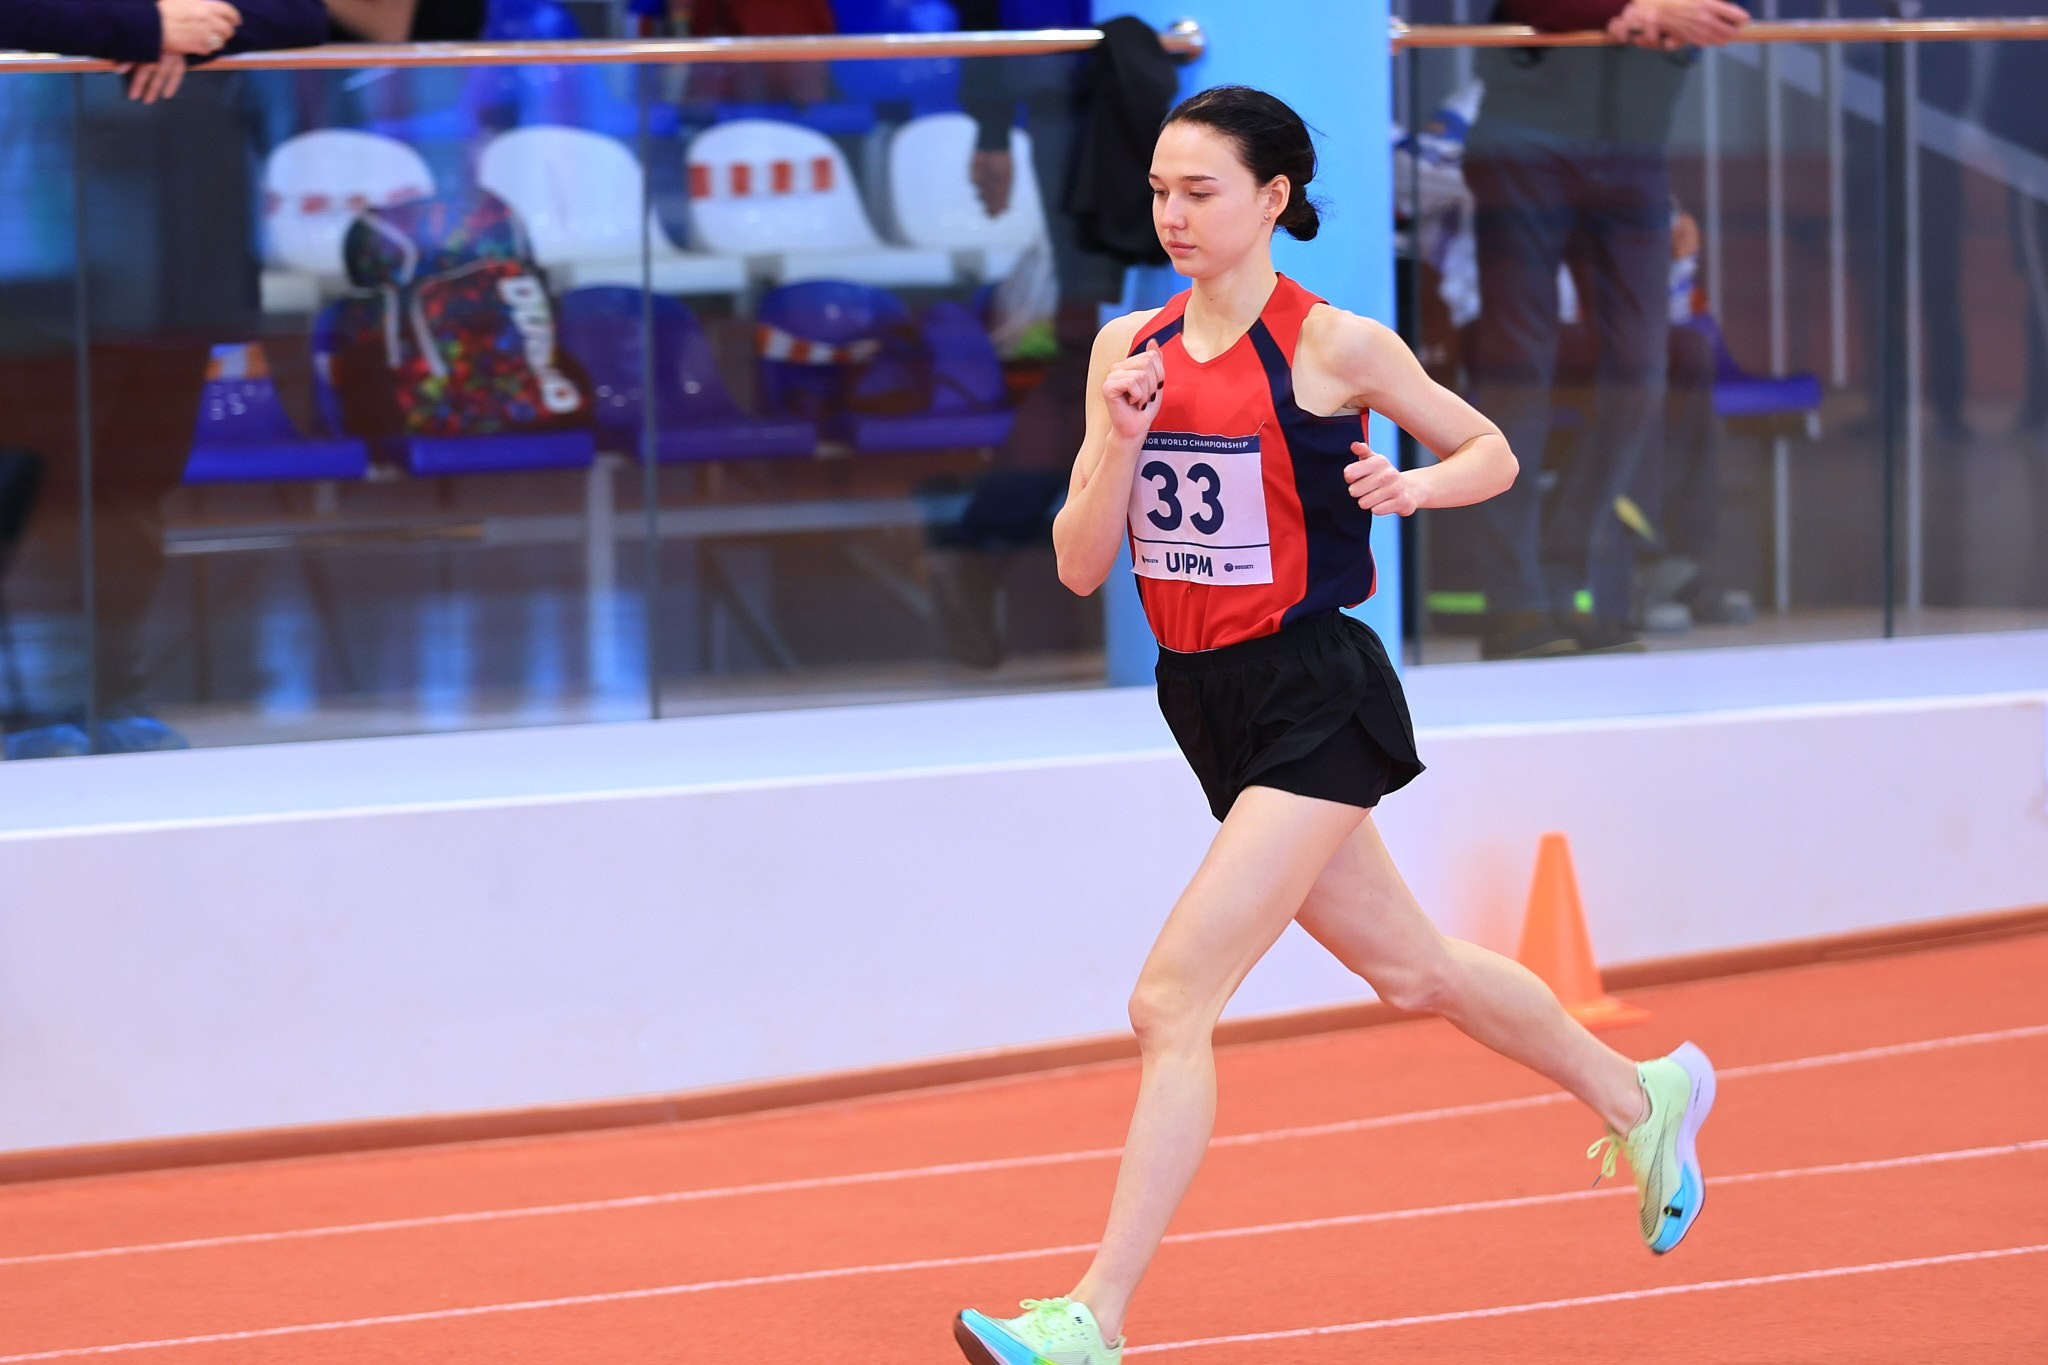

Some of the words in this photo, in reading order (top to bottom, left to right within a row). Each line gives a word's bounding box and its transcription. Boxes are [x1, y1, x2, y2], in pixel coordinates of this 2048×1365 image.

[1145, 437, 1159, 445] IOR
[1160, 438, 1188, 446] WORLD
[1189, 440, 1249, 449] CHAMPIONSHIP
[1141, 460, 1224, 535] 33
[1165, 551, 1213, 577] UIPM
